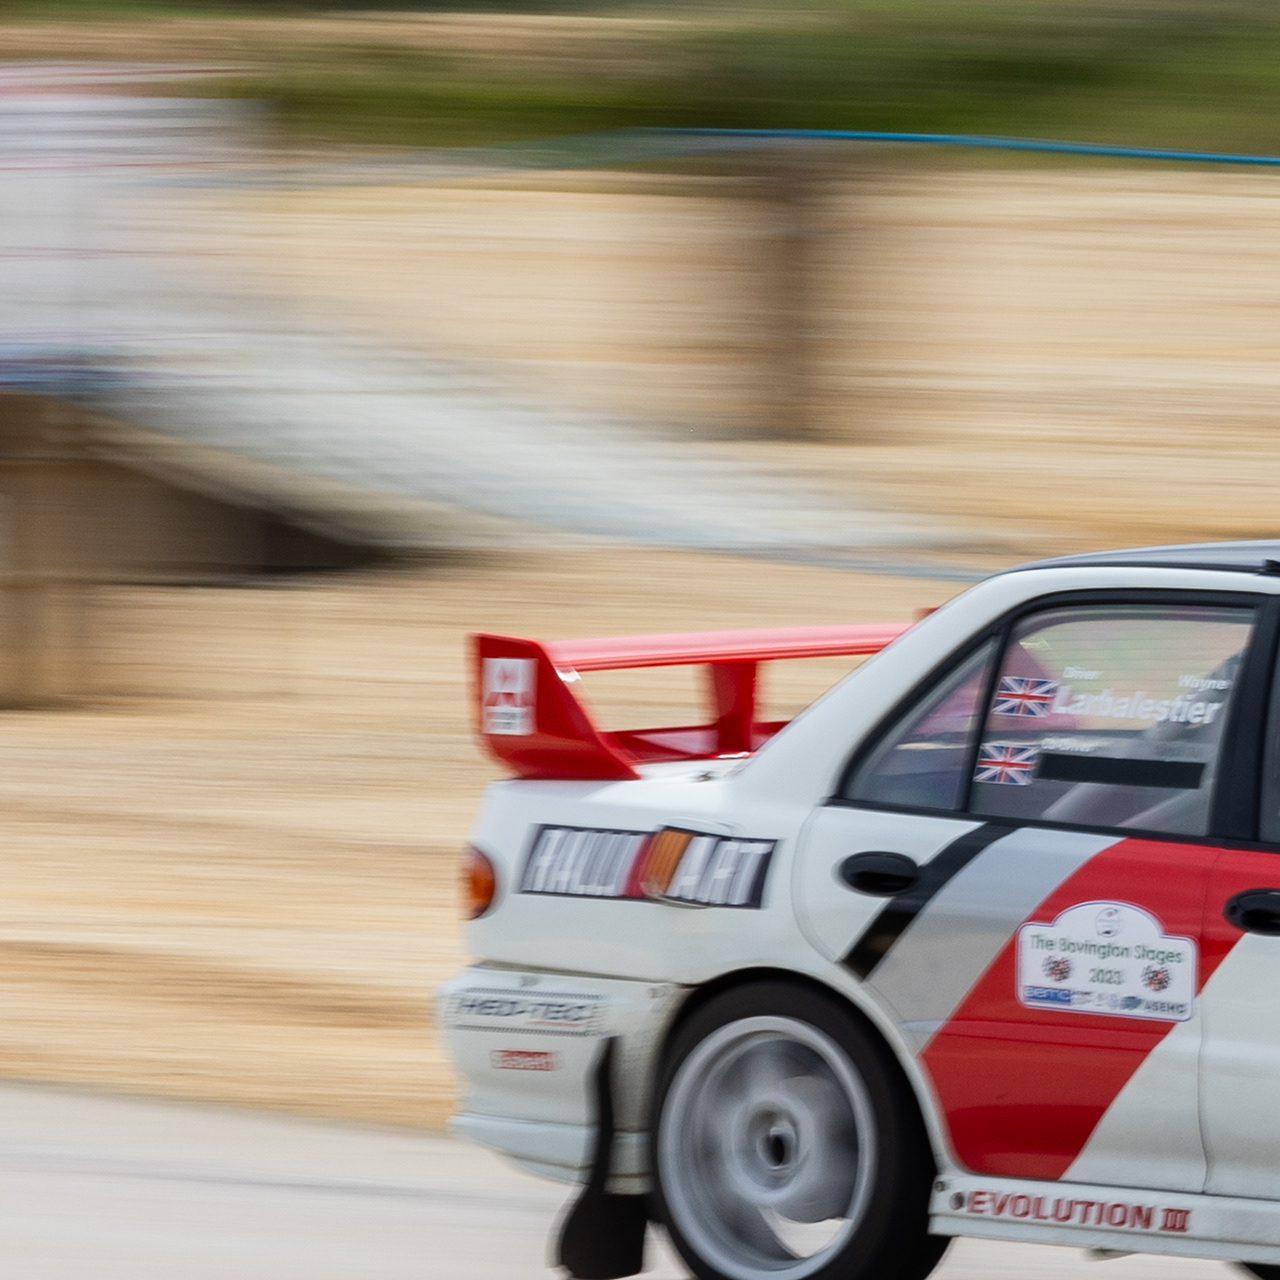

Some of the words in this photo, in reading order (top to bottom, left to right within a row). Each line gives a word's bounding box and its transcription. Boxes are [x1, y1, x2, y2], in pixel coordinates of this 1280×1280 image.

[1178, 674, 1232, 692] Wayne
[1051, 685, 1223, 724] Larbalestier
[1030, 934, 1055, 950] The
[1059, 938, 1130, 960] Bovington
[1134, 945, 1184, 965] Stages
[1088, 968, 1125, 985] 2023
[966, 1190, 1154, 1230] EVOLUTION
[1159, 1207, 1192, 1233] III
